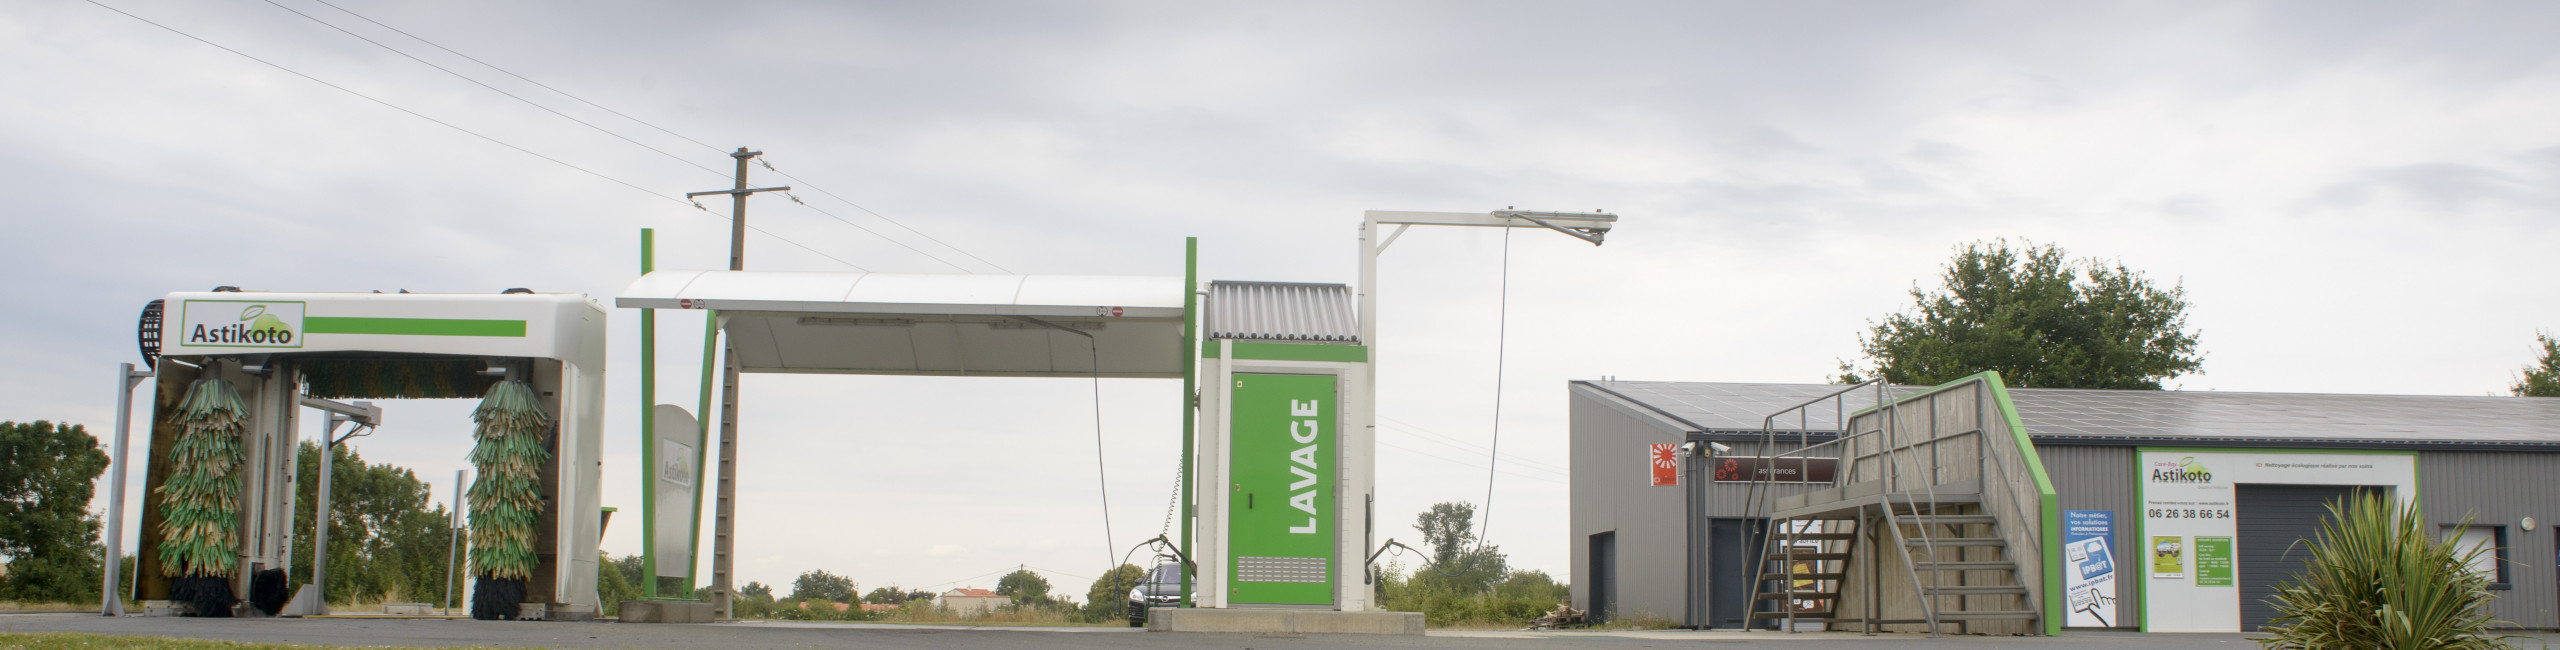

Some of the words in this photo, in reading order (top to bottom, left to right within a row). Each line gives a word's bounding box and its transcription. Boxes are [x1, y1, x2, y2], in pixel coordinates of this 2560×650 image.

[191, 323, 292, 344] Astikoto
[1289, 399, 1318, 534] LAVAGE
[2152, 468, 2212, 482] Astikoto
[2148, 509, 2162, 518] 06
[2165, 509, 2179, 518] 26
[2182, 509, 2196, 519] 38
[2199, 509, 2213, 519] 66
[2216, 509, 2229, 519] 54
